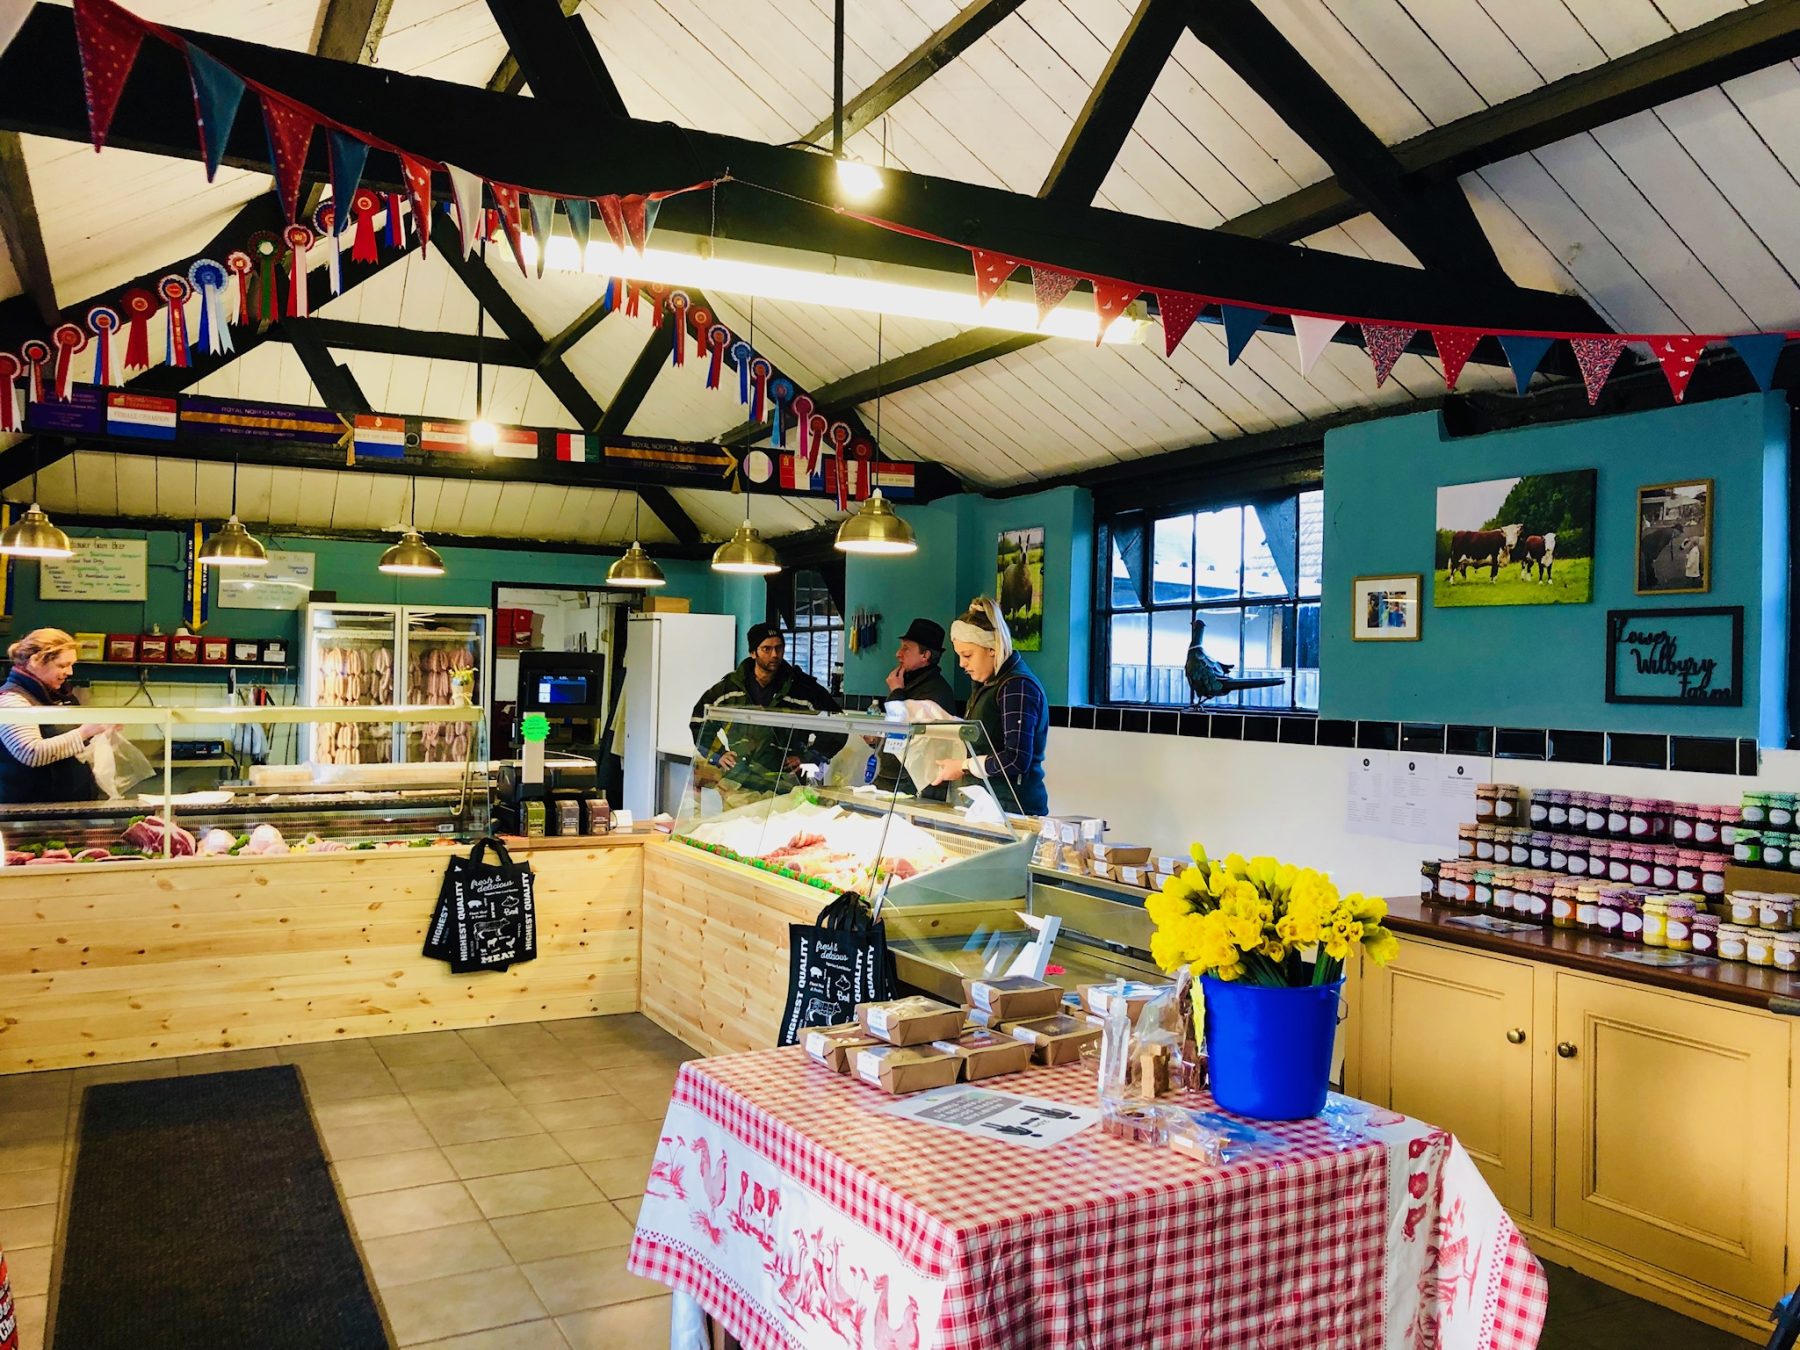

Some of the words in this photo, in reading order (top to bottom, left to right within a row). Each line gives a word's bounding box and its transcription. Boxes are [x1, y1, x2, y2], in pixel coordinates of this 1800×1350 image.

[220, 406, 243, 414] ROYAL
[631, 440, 650, 449] ROYAL
[455, 881, 466, 921] QUALITY
[470, 876, 493, 890] fresh
[476, 880, 515, 893] delicious
[521, 872, 532, 911] QUALITY
[432, 905, 448, 945] HIGHEST
[459, 923, 468, 961] HIGHEST
[525, 913, 533, 951] HIGHEST
[480, 950, 516, 964] MEAT
[854, 949, 863, 1002] QUALITY
[867, 945, 875, 999] QUALITY
[786, 991, 804, 1044] HIGHEST
[798, 937, 808, 988] QUALITY
